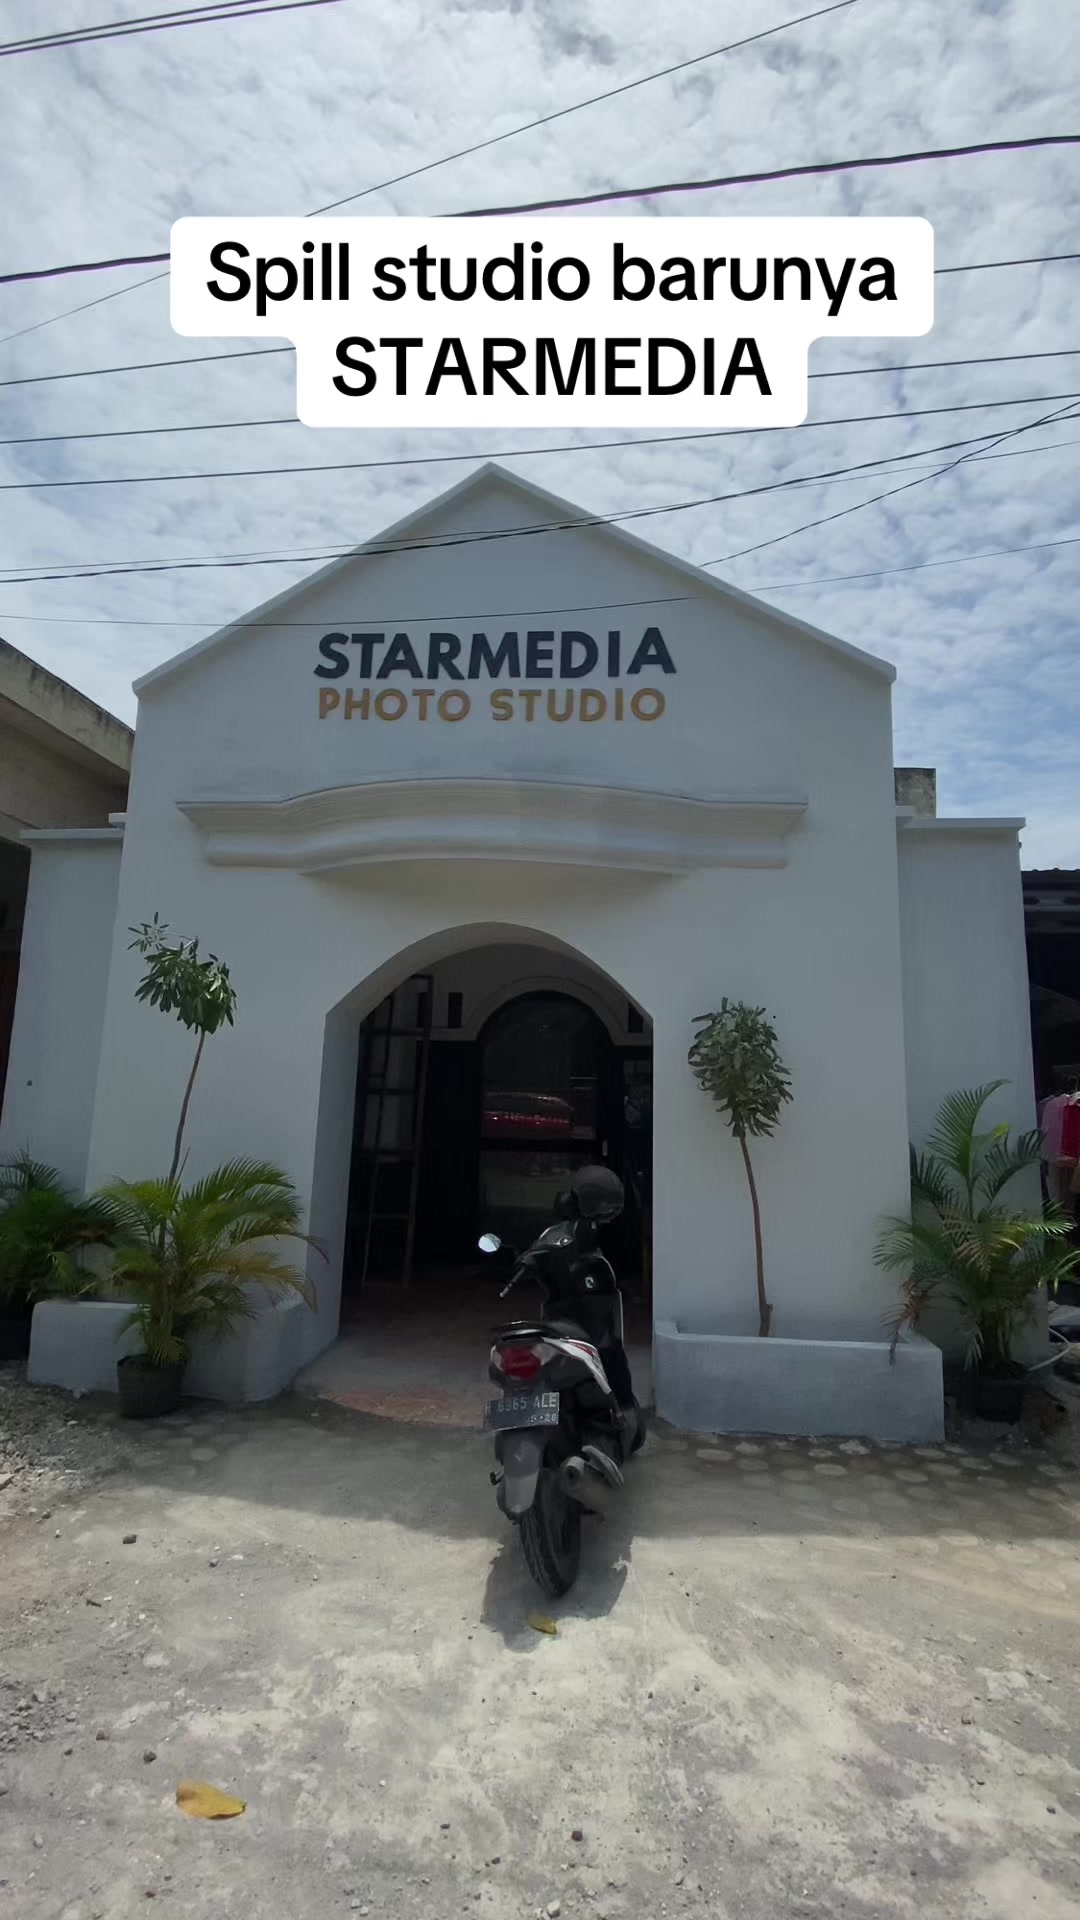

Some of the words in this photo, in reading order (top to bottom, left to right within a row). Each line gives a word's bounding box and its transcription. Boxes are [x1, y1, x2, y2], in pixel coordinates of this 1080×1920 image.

[314, 627, 676, 680] STARMEDIA
[319, 688, 471, 722] PHOTO
[490, 688, 666, 723] STUDIO
[533, 1393, 558, 1408] ALE
